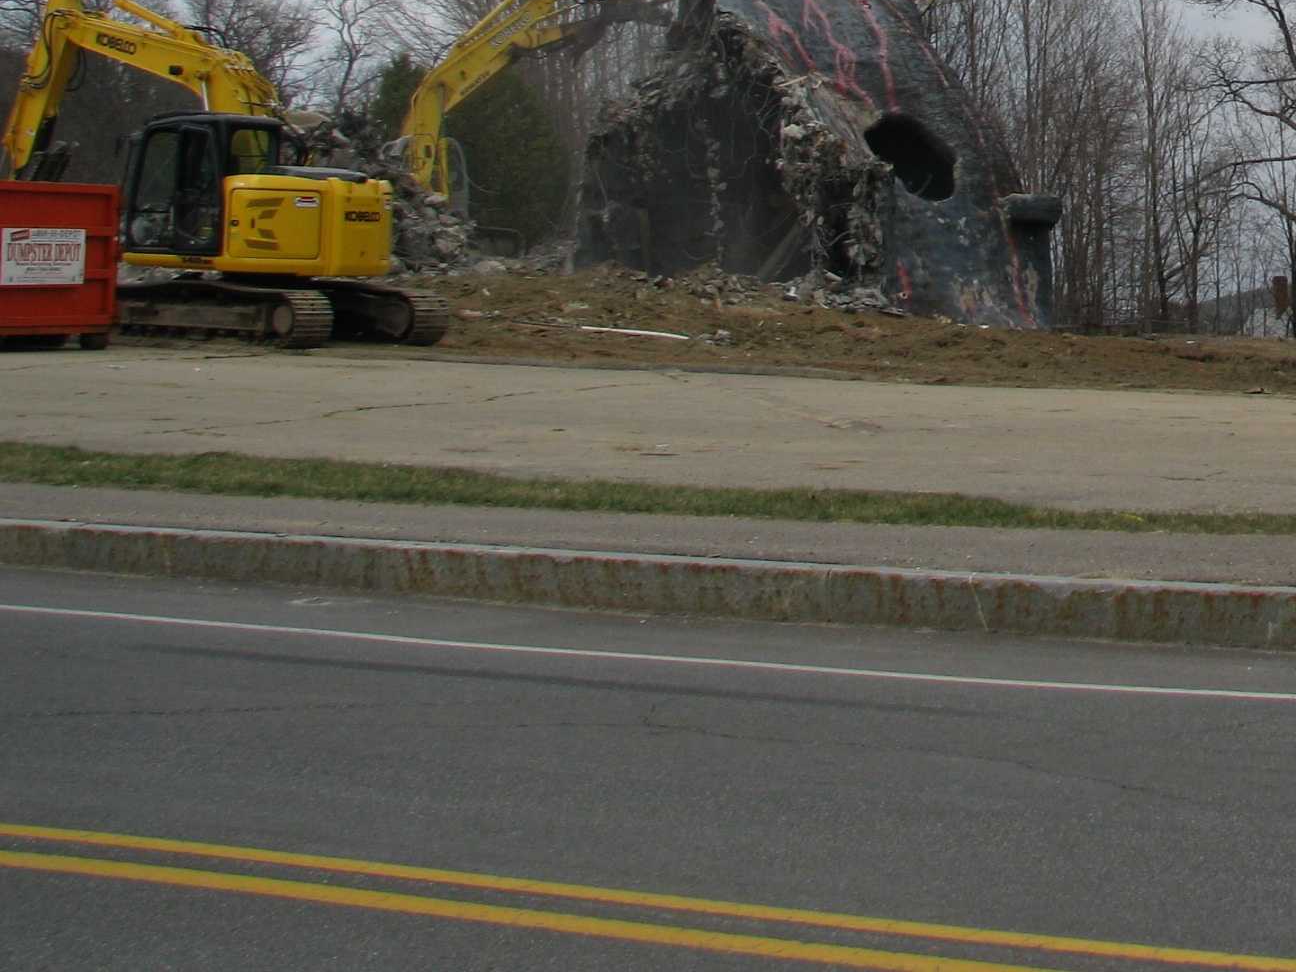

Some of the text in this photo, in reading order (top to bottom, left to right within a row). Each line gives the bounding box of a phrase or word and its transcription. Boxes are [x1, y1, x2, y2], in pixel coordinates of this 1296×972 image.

[96, 32, 137, 56] KOBELCO
[345, 211, 381, 222] KOBELCO
[7, 243, 81, 262] DUMPSTER DEPOT
